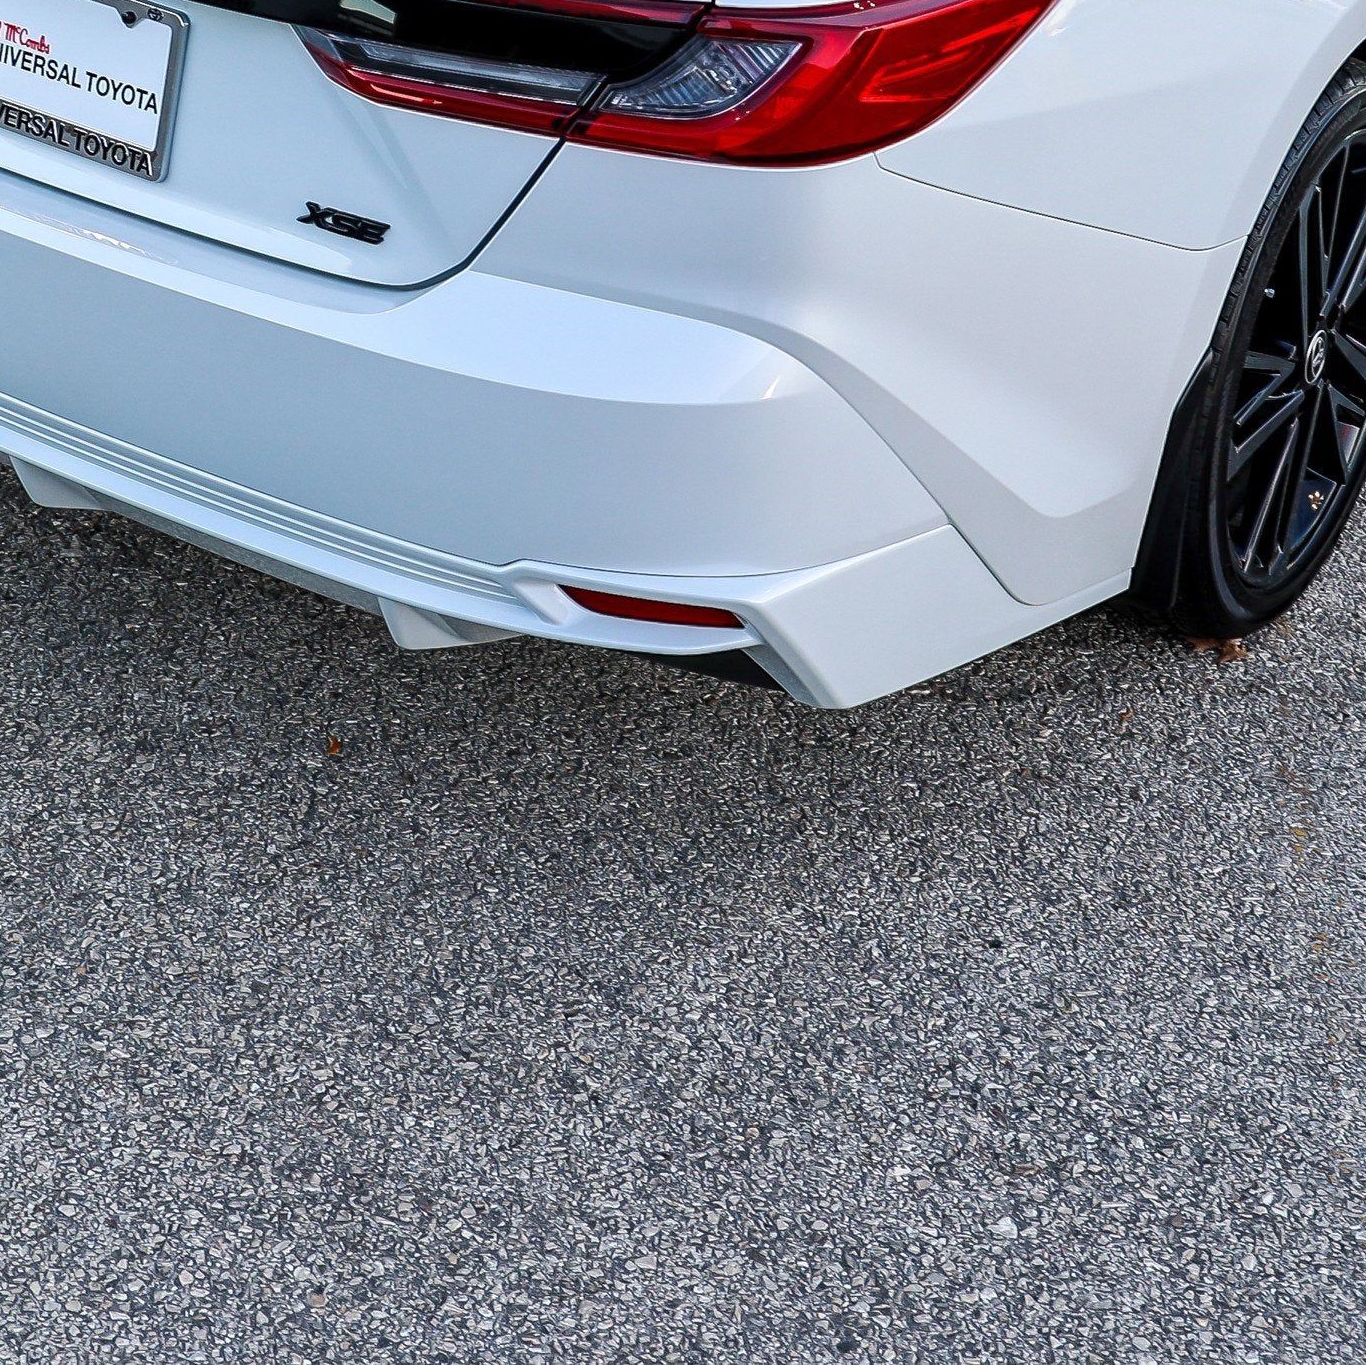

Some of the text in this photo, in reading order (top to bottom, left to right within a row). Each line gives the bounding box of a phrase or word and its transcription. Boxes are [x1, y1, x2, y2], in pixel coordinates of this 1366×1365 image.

[4, 21, 50, 54] McCombs
[85, 70, 159, 115] TOYOTA
[73, 127, 153, 177] TOYOTA
[295, 201, 391, 245] XSE
